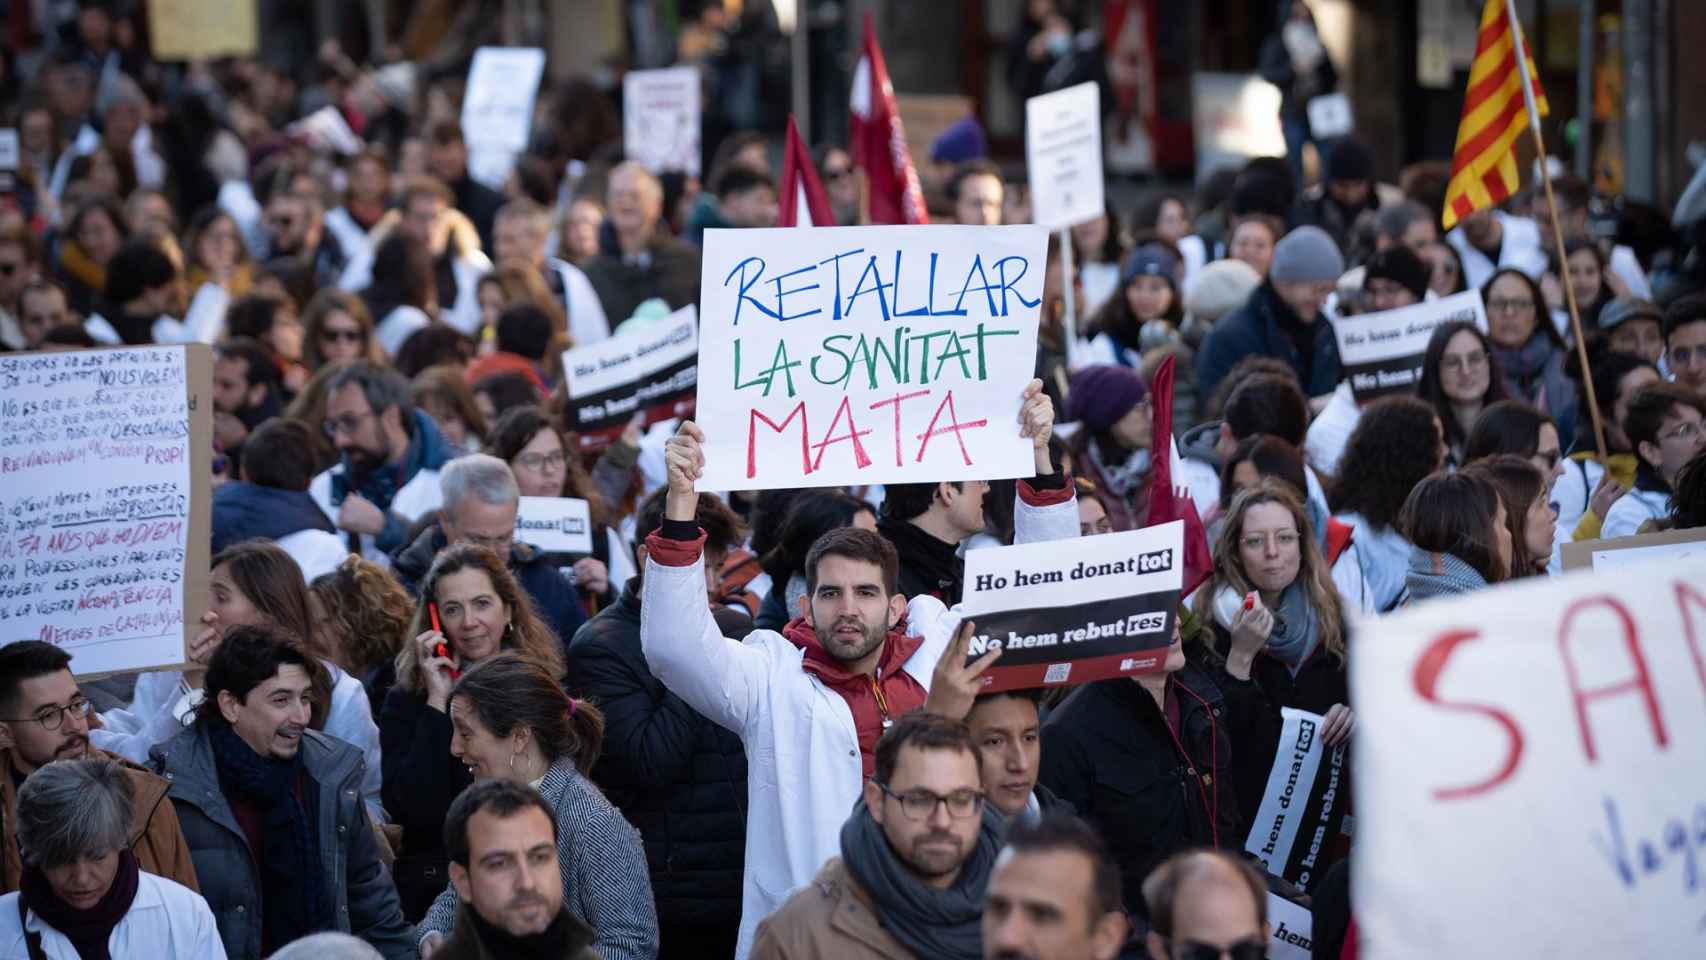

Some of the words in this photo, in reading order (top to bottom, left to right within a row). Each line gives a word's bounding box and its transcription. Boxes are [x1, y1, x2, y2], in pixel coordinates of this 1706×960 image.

[724, 248, 1042, 326] RETALLAR
[733, 337, 802, 398] LA
[746, 389, 988, 479] MATA
[975, 573, 1008, 592] Ho
[1013, 569, 1064, 588] hem
[1070, 556, 1136, 581] donat
[1139, 549, 1171, 570] tot
[1006, 629, 1059, 650] hem
[1062, 618, 1126, 643] rebut
[1128, 614, 1165, 632] res
[1261, 813, 1286, 856] hem
[1278, 752, 1304, 810] donat
[1298, 719, 1316, 751] tot
[1301, 825, 1327, 871] hem
[1319, 766, 1341, 823] rebut
